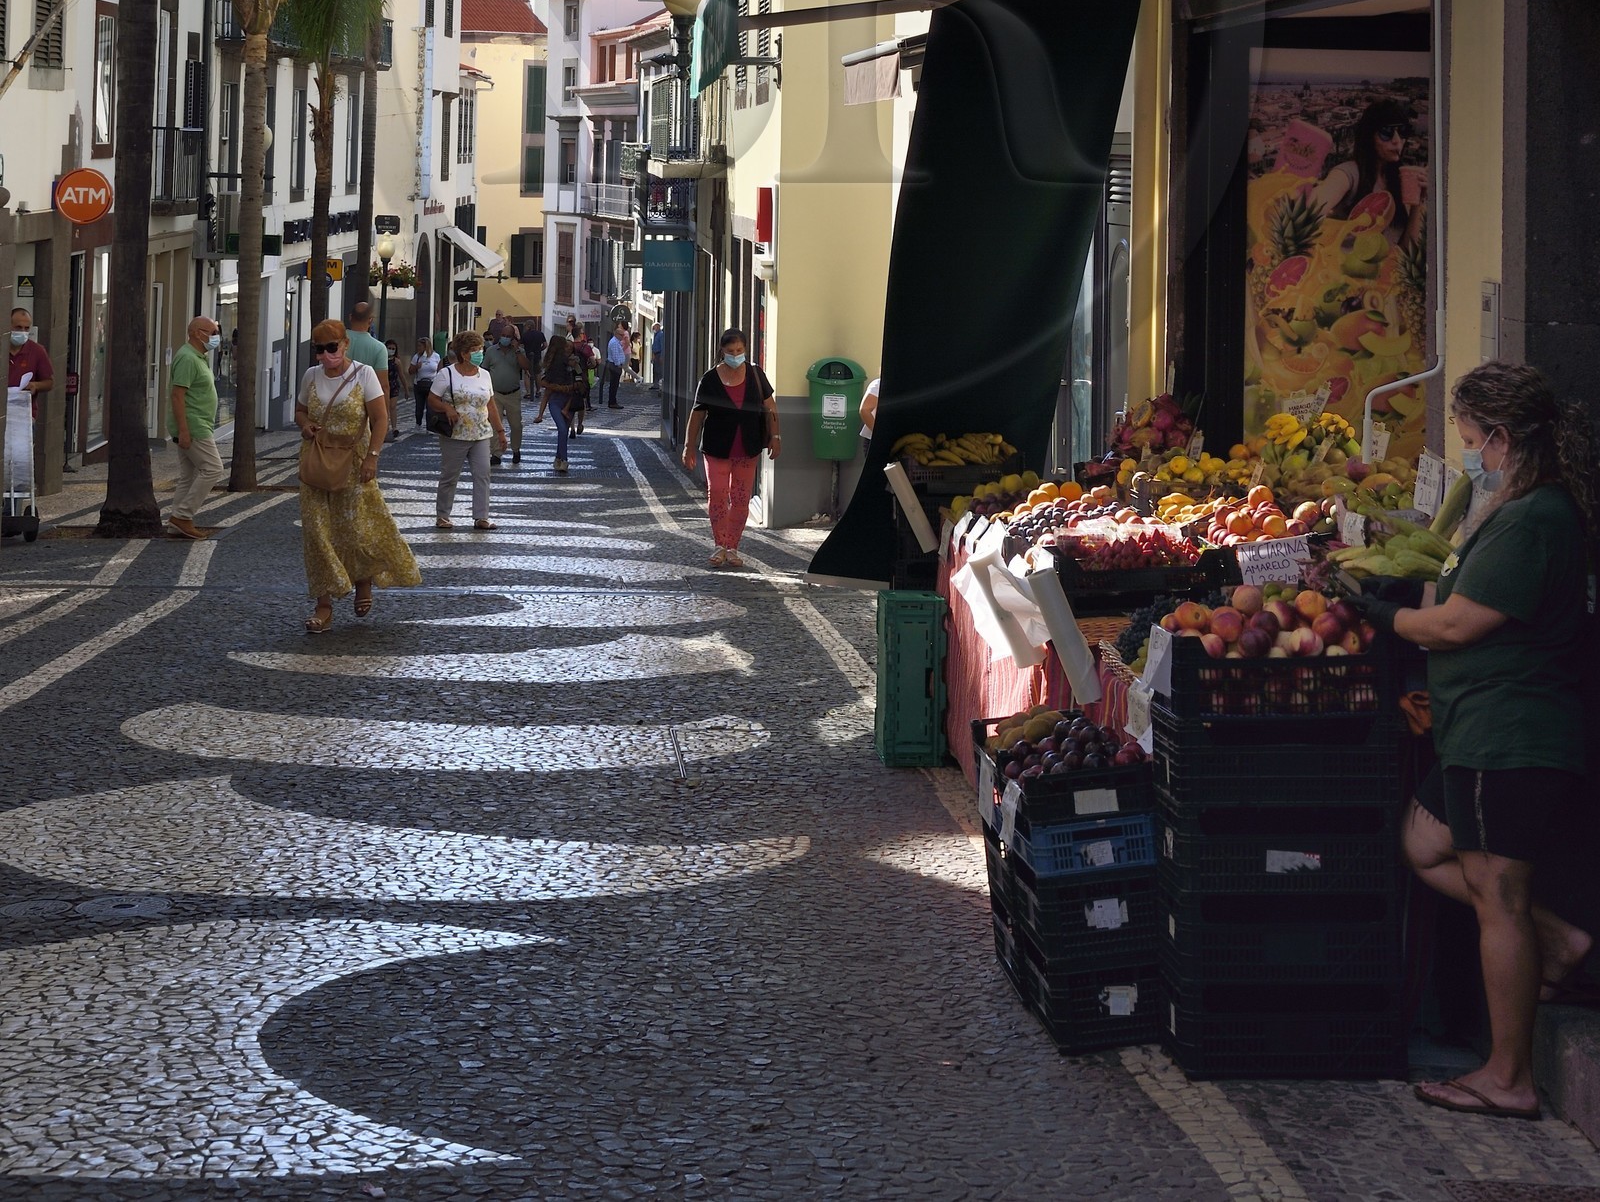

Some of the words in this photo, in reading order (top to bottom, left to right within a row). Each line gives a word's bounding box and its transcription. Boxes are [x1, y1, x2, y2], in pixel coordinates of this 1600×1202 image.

[60, 186, 106, 205] ATM
[1241, 539, 1307, 563] NECTARINA
[1245, 558, 1291, 575] AMARELO
